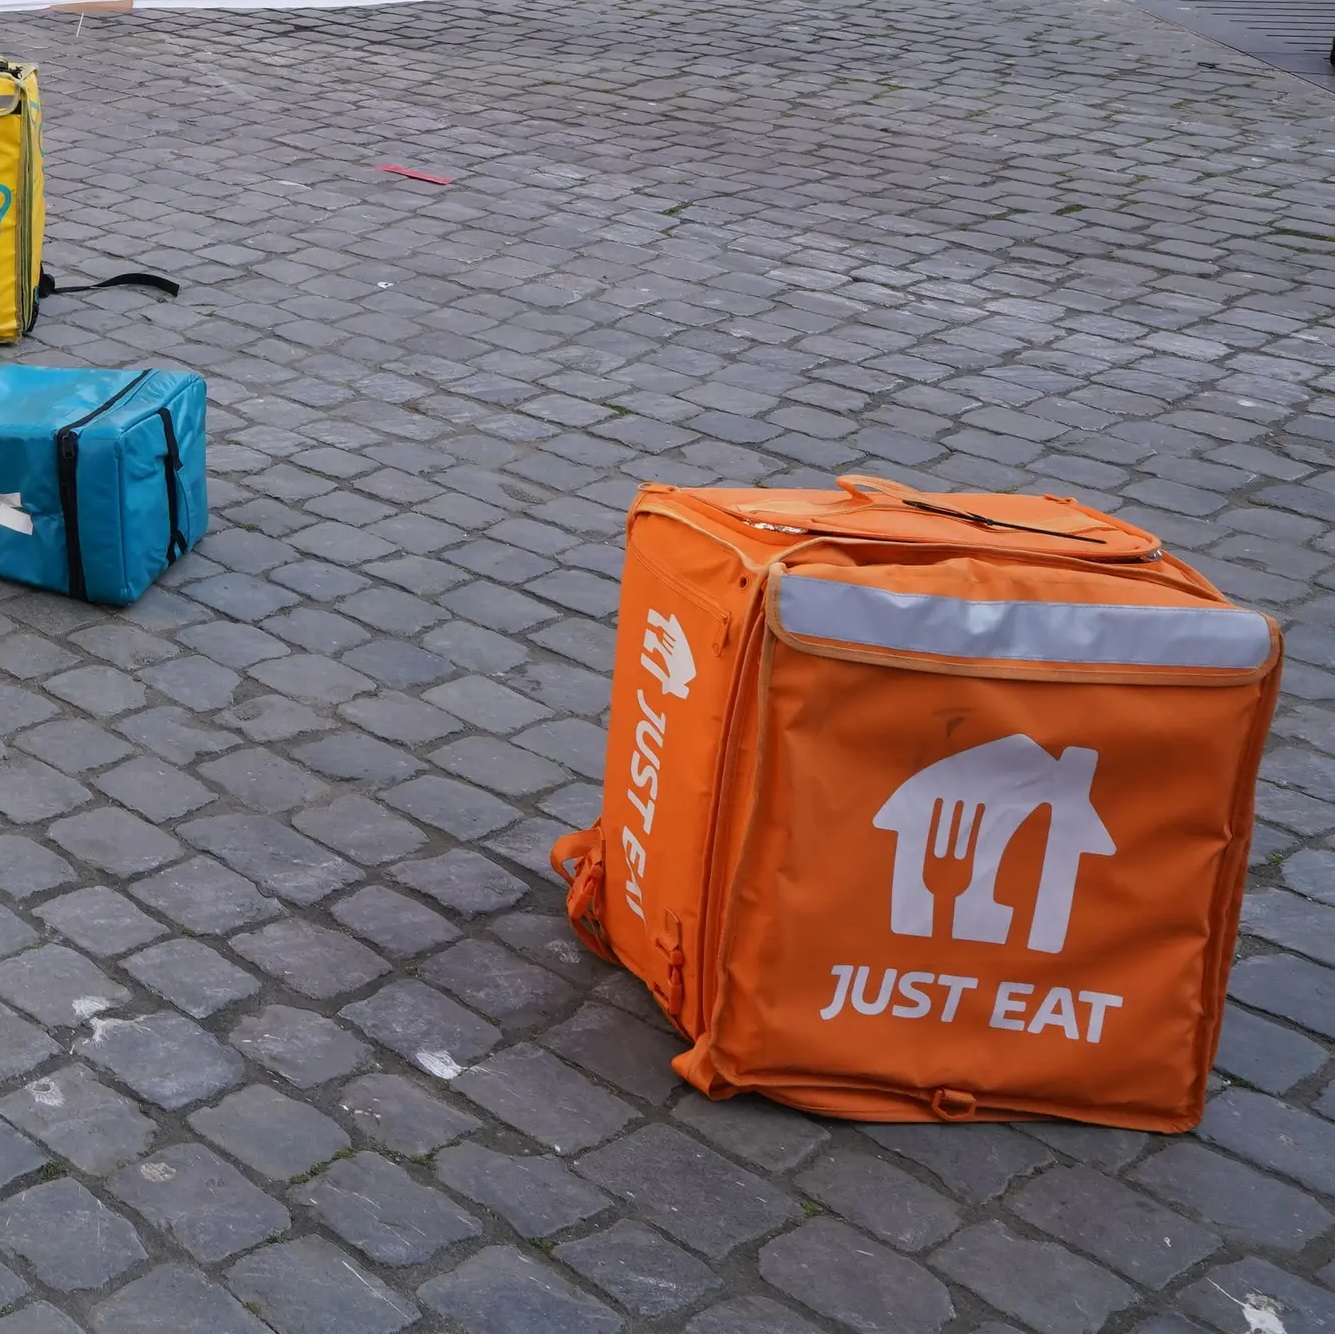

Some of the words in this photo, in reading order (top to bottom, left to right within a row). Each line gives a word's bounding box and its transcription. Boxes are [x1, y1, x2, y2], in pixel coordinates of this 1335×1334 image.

[626, 688, 666, 835] JUST
[820, 964, 979, 1023] JUST
[989, 981, 1124, 1043] EAT
